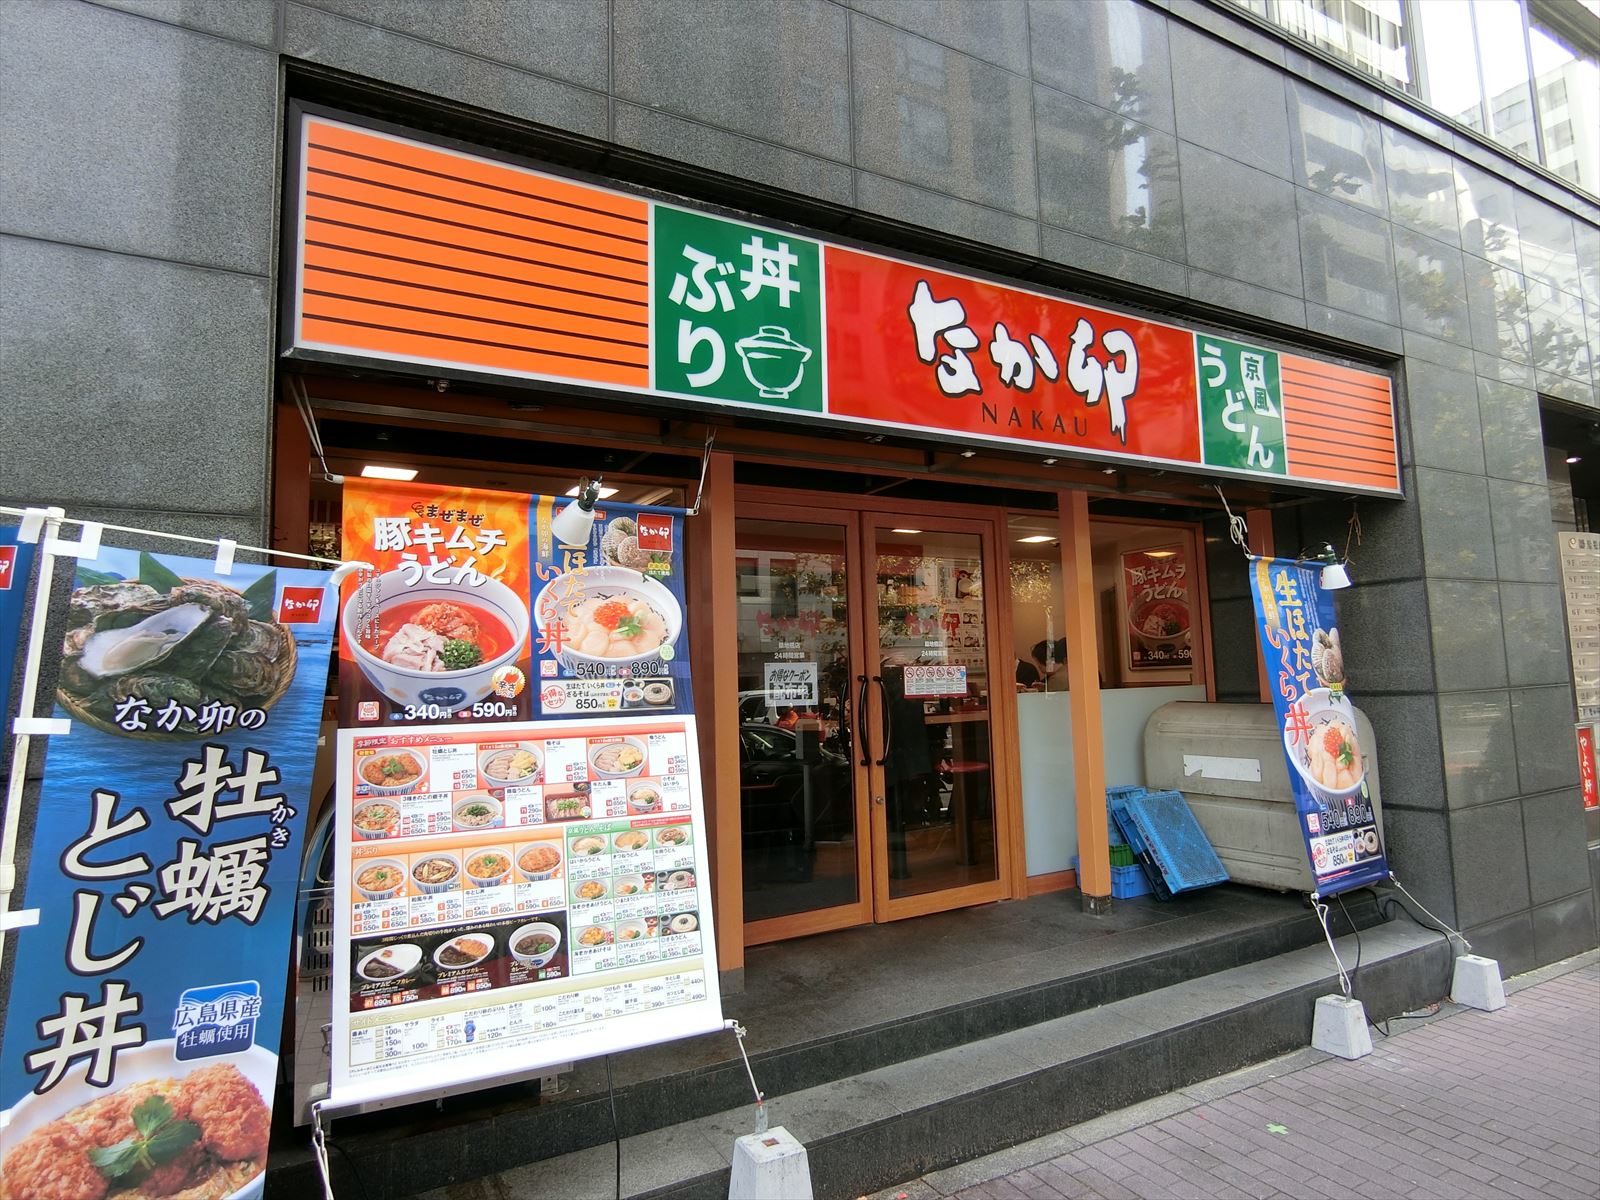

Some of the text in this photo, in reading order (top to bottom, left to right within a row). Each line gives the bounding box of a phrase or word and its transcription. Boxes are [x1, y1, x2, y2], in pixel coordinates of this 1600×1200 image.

[908, 279, 1138, 445] なか卯
[1243, 355, 1269, 412] 京風
[982, 402, 1088, 438] NAKAU
[1200, 343, 1275, 469] うどん
[426, 504, 484, 527] まぜまぜ
[640, 525, 670, 539] なか卯
[373, 517, 507, 556] 豚キムチ
[398, 553, 487, 587] うどん
[558, 544, 588, 618] ほたて
[284, 598, 320, 611] なか卯
[535, 562, 571, 654] いくら丼
[1141, 582, 1182, 602] うどん
[1275, 570, 1313, 698] 生ほたて
[1265, 624, 1314, 746] いくら丼
[114, 695, 267, 734] なか卯の
[390, 736, 452, 745] おすすめメニュー
[156, 746, 284, 923] 牡蠣
[271, 803, 296, 849] かき
[26, 790, 154, 1094] とじ丼
[174, 995, 262, 1030] 広島県産
[180, 1022, 251, 1051] 牡蠣使用
